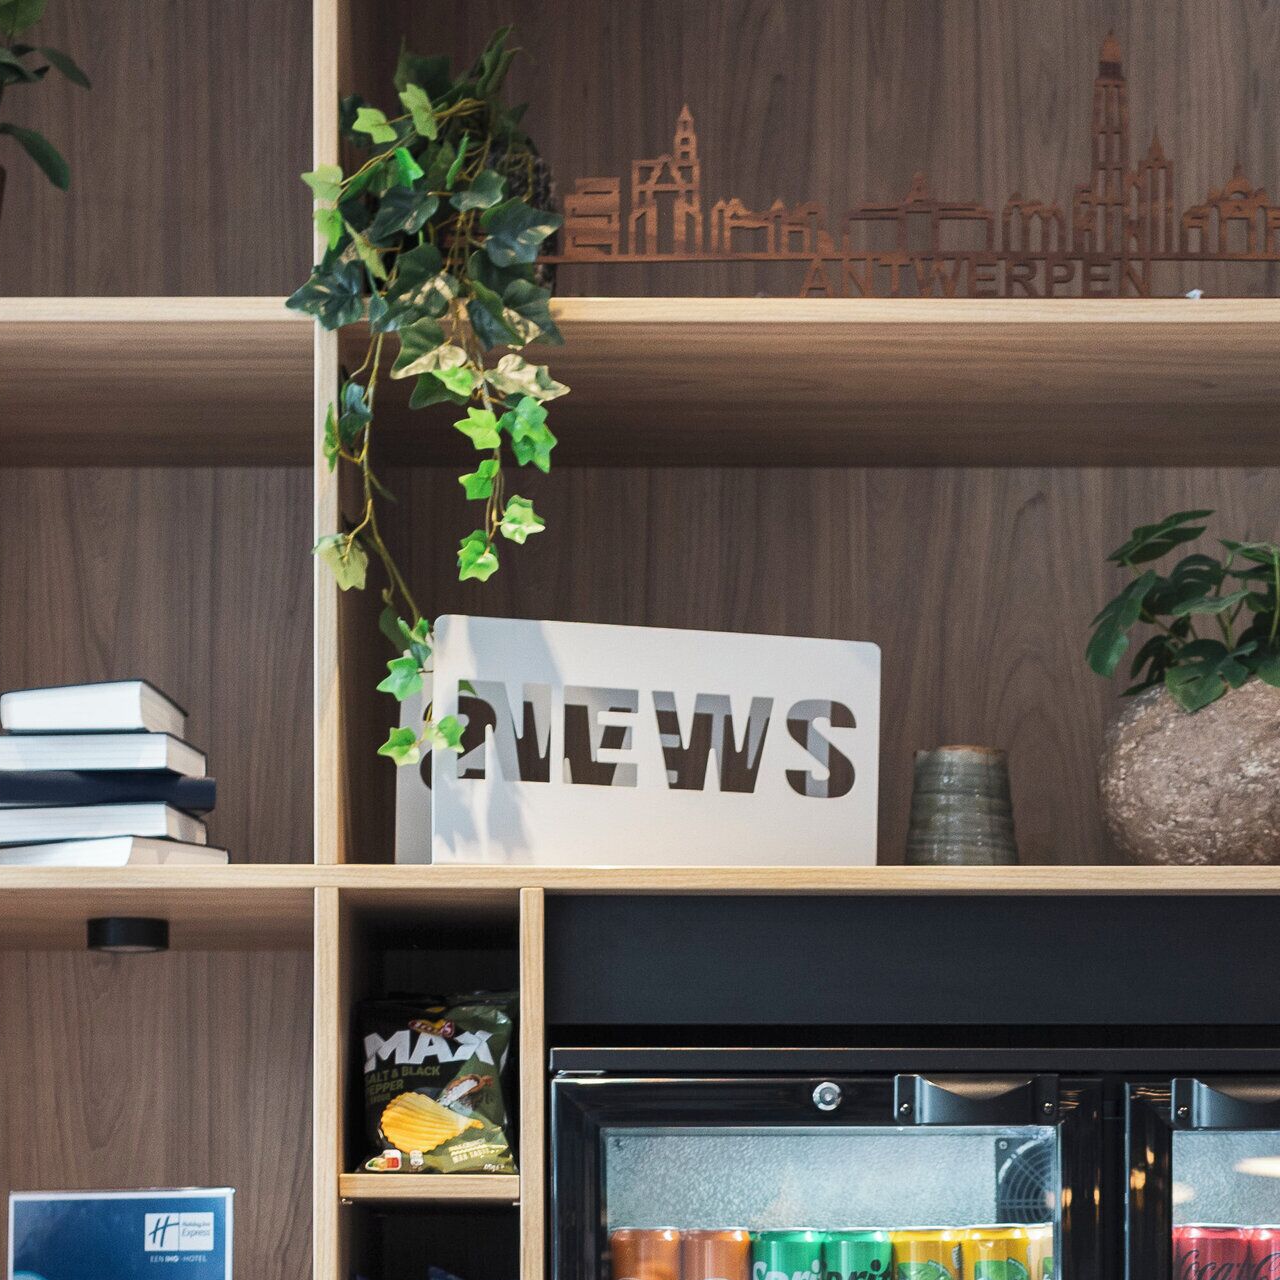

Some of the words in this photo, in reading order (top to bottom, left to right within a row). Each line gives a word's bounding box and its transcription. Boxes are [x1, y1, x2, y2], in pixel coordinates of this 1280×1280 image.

[800, 258, 1151, 298] ANTWERPEN
[456, 679, 858, 799] NEWS
[363, 1030, 495, 1074] MAX
[402, 1065, 441, 1078] BLACK
